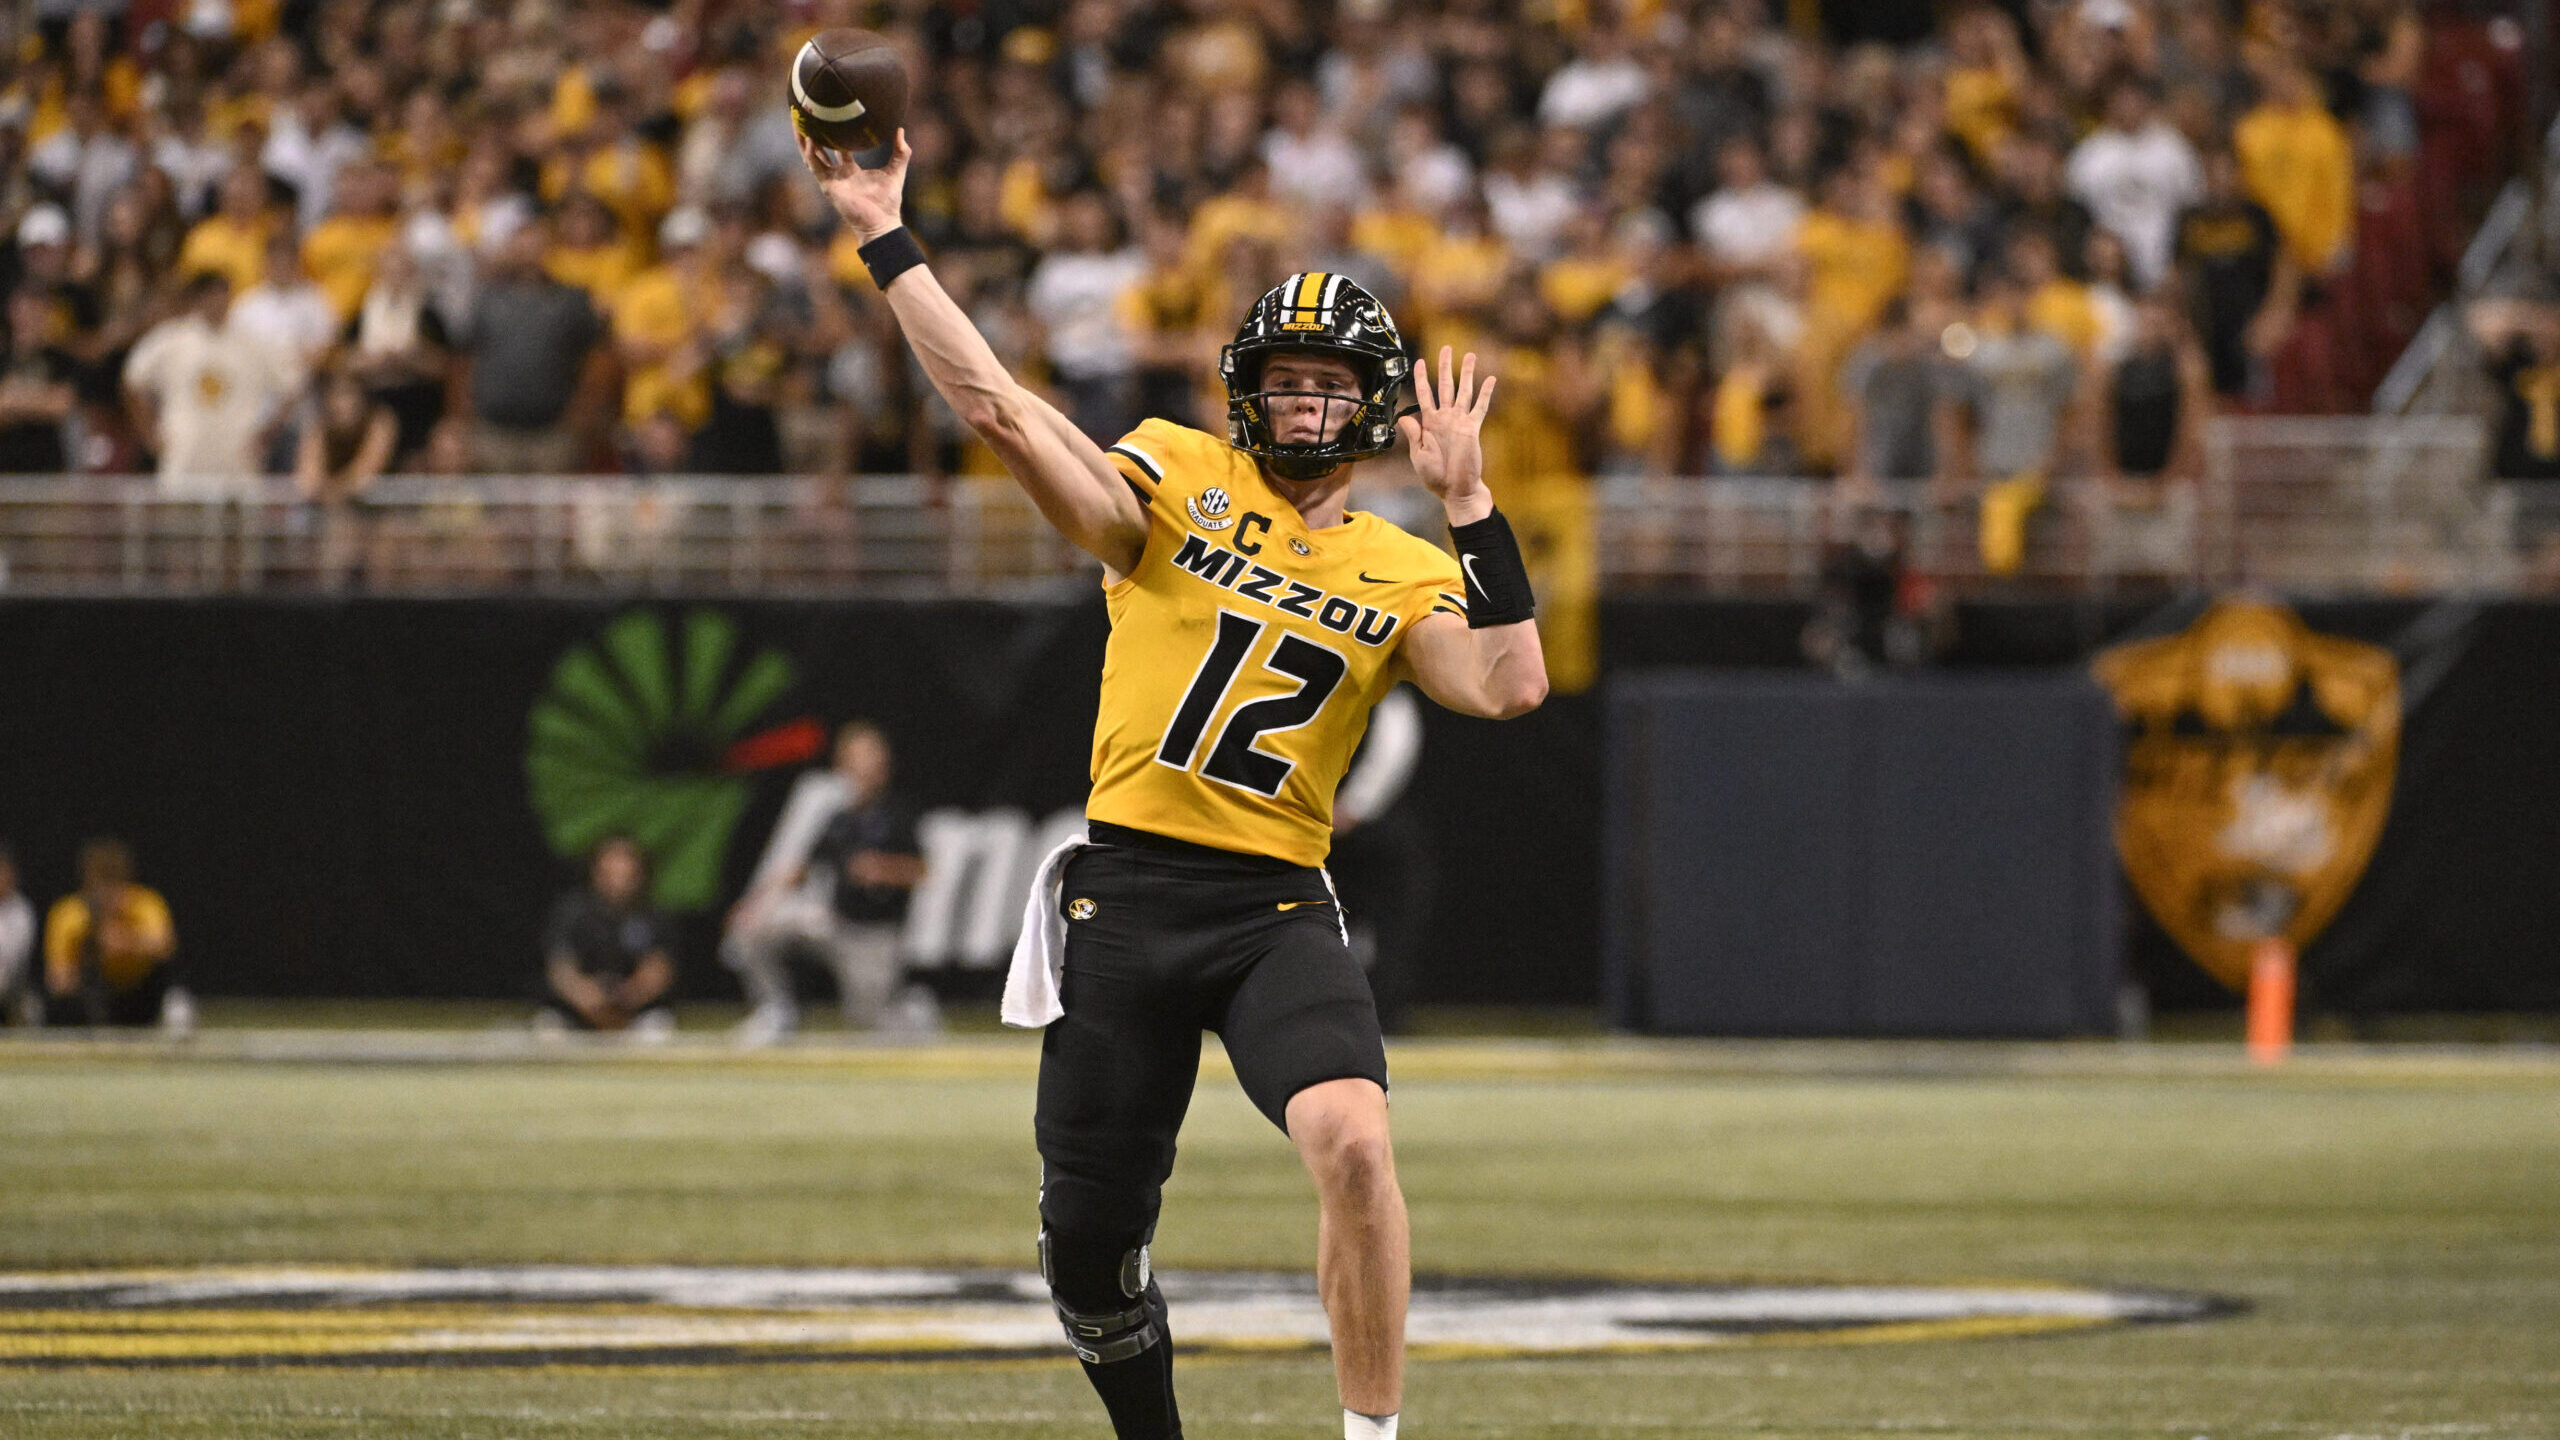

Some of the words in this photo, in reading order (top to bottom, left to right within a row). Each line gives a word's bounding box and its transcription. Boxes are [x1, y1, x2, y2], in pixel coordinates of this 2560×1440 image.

[1282, 322, 1325, 332] MIZZOU
[1188, 504, 1224, 529] GRADUATE
[1201, 487, 1229, 514] SEC
[1232, 511, 1272, 556] C
[1170, 530, 1400, 647] MIZZOU
[1154, 606, 1349, 799] 12
